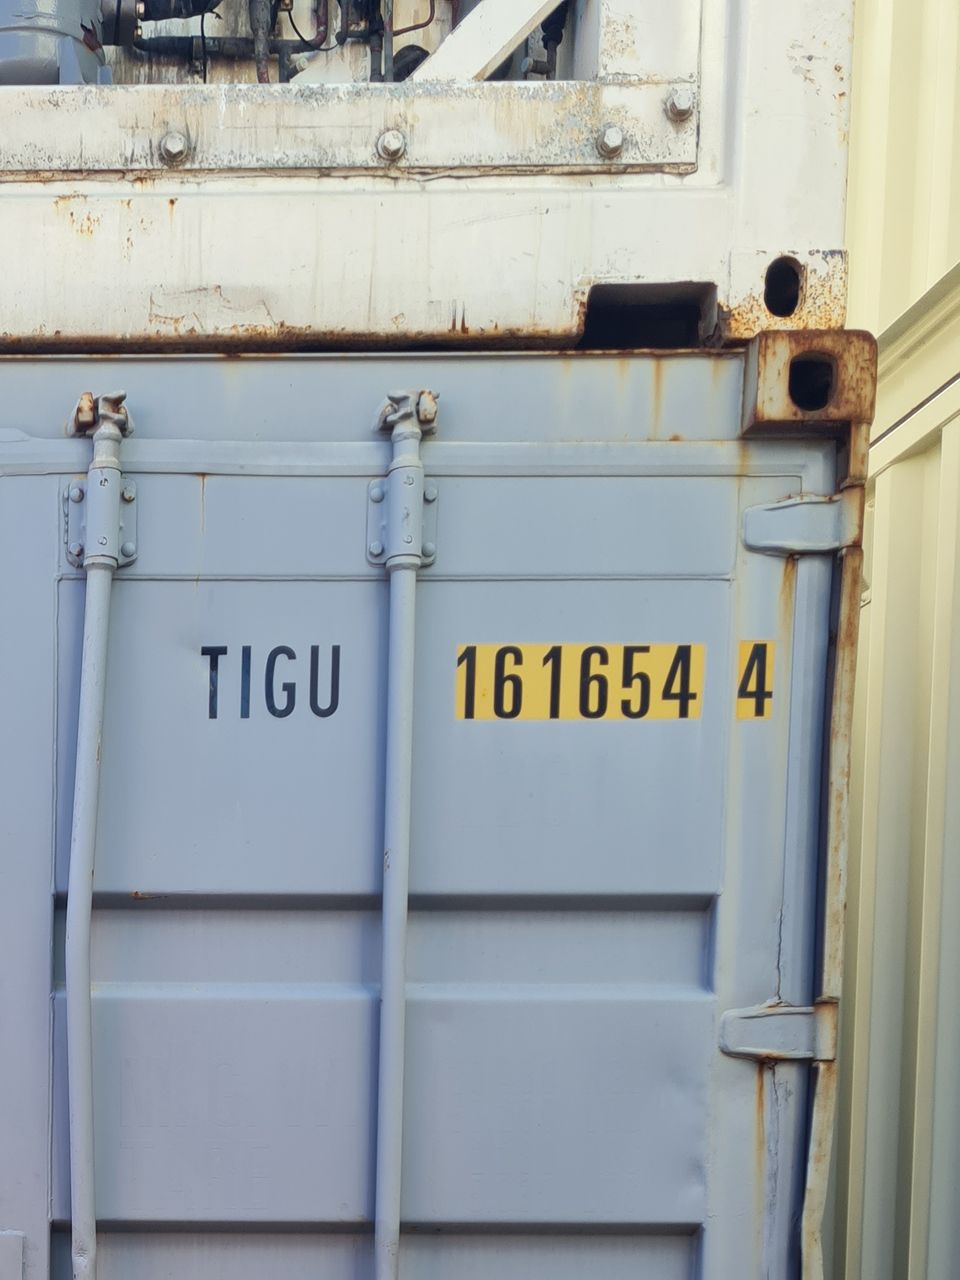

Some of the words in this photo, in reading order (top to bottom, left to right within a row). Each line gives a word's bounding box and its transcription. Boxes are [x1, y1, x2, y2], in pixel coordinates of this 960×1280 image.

[201, 645, 340, 719] TIGU
[456, 644, 697, 719] 161654
[737, 643, 773, 717] 4
